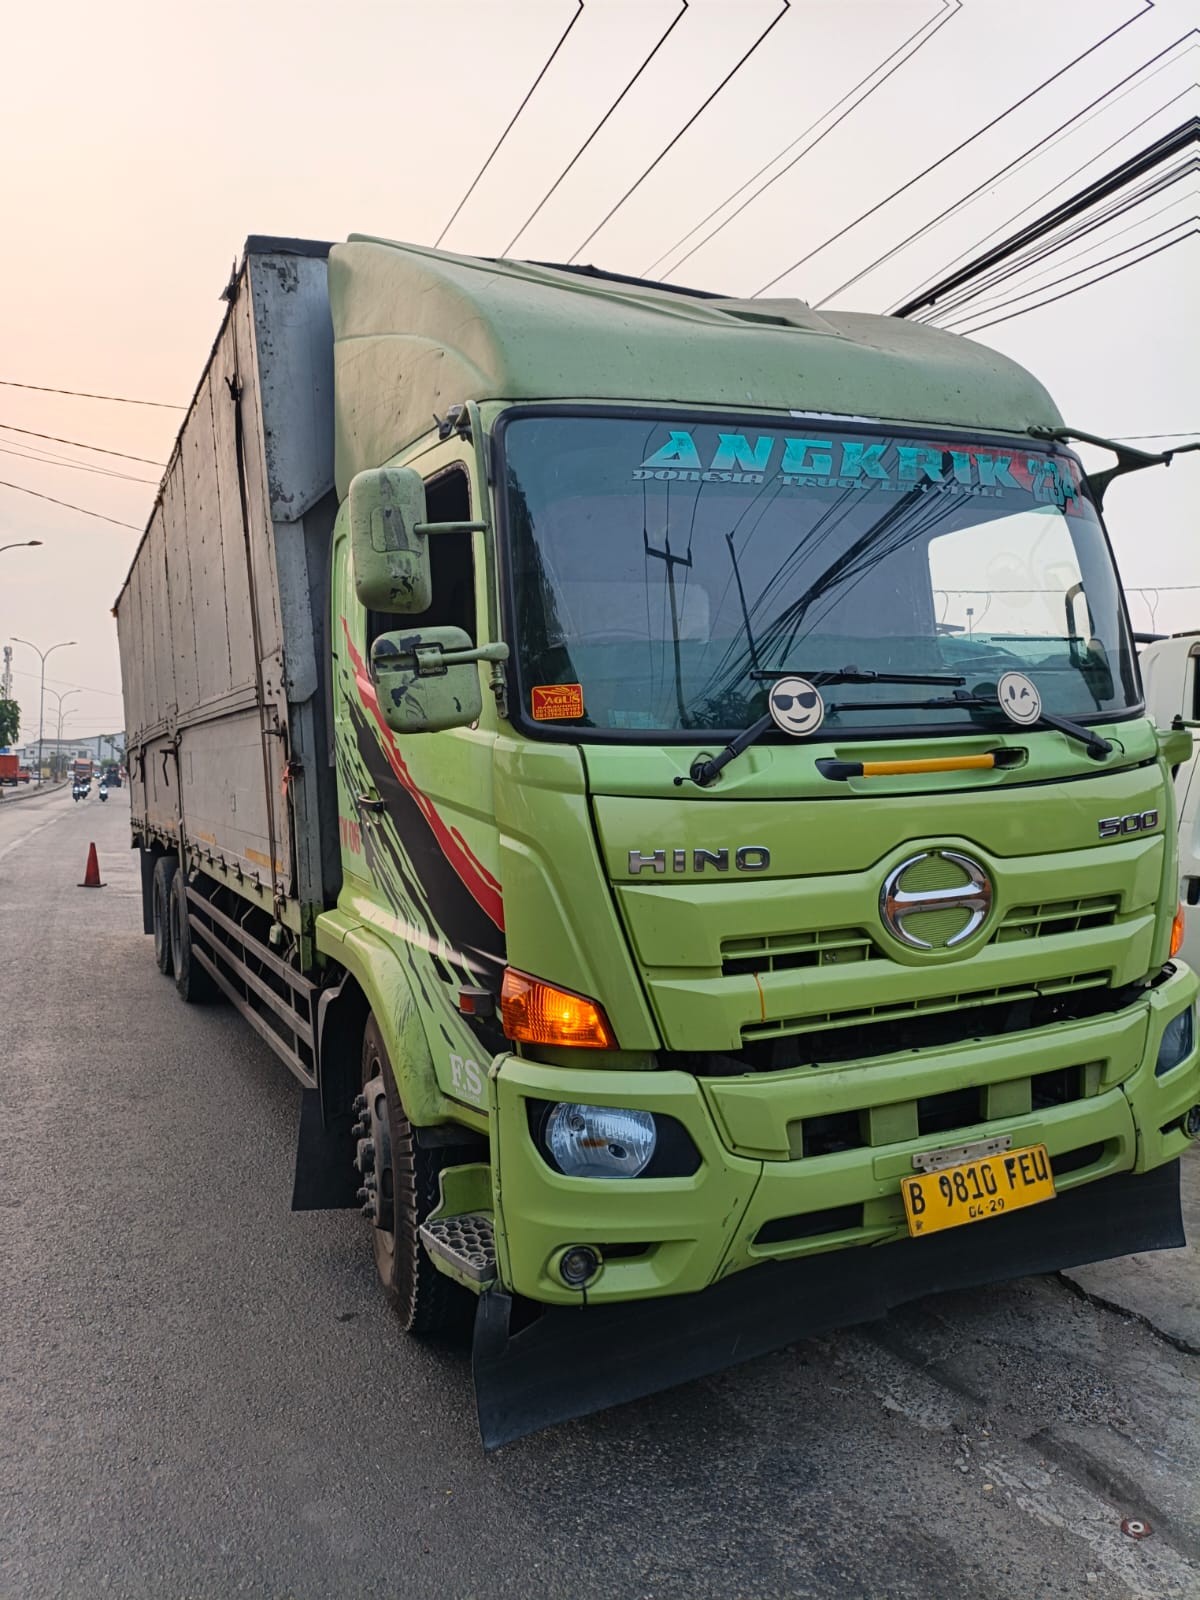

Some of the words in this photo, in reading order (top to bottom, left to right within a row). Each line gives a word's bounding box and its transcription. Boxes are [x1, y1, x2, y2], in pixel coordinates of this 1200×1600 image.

[640, 431, 1021, 489] ANGKRIK
[1098, 809, 1158, 838] 500
[628, 845, 770, 874] HINO
[909, 1183, 926, 1215] B
[938, 1164, 998, 1207] 9810
[1003, 1150, 1049, 1190] FEU
